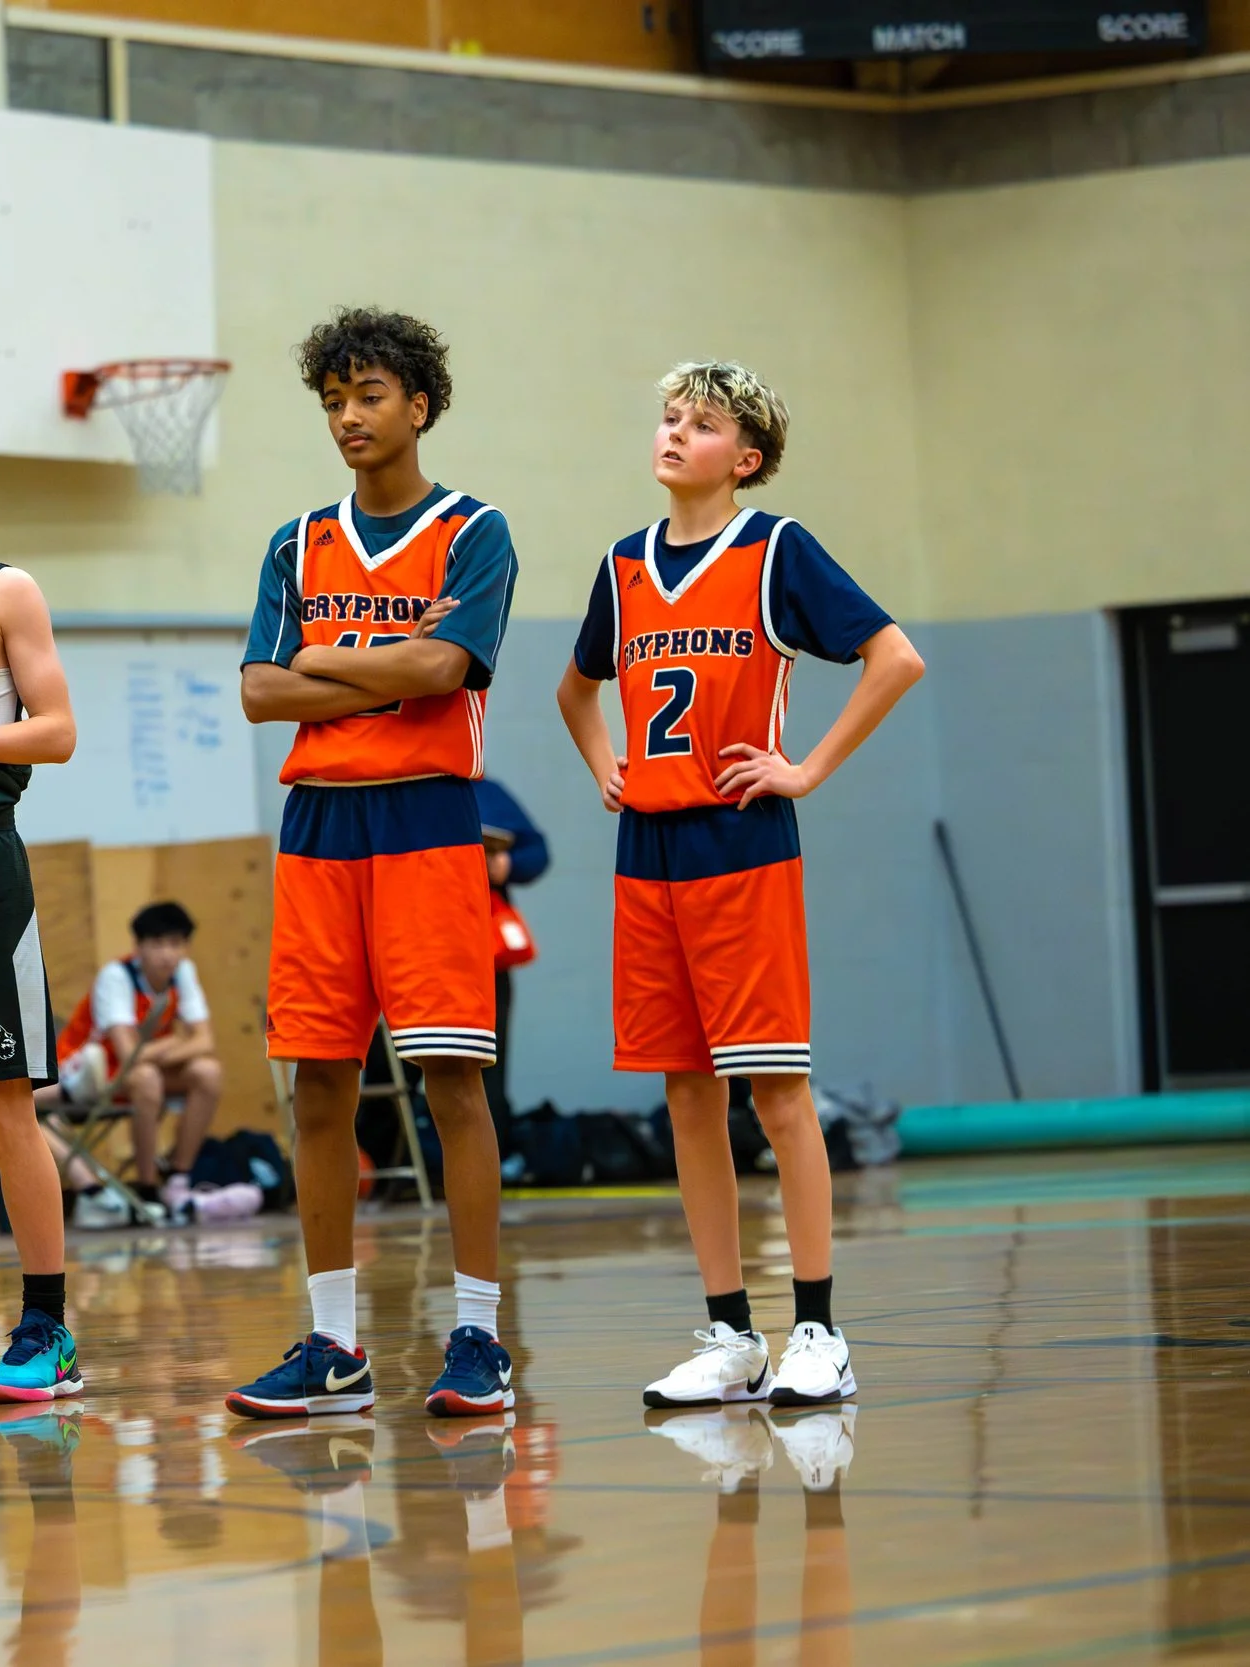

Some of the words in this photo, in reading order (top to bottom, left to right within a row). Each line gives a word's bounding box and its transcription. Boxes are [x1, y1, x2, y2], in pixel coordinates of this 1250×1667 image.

[872, 22, 966, 51] MATCH
[1097, 12, 1188, 41] SCORE
[301, 593, 440, 624] GRYPHON
[624, 627, 754, 673] GRYPHONS
[645, 666, 697, 760] 2
